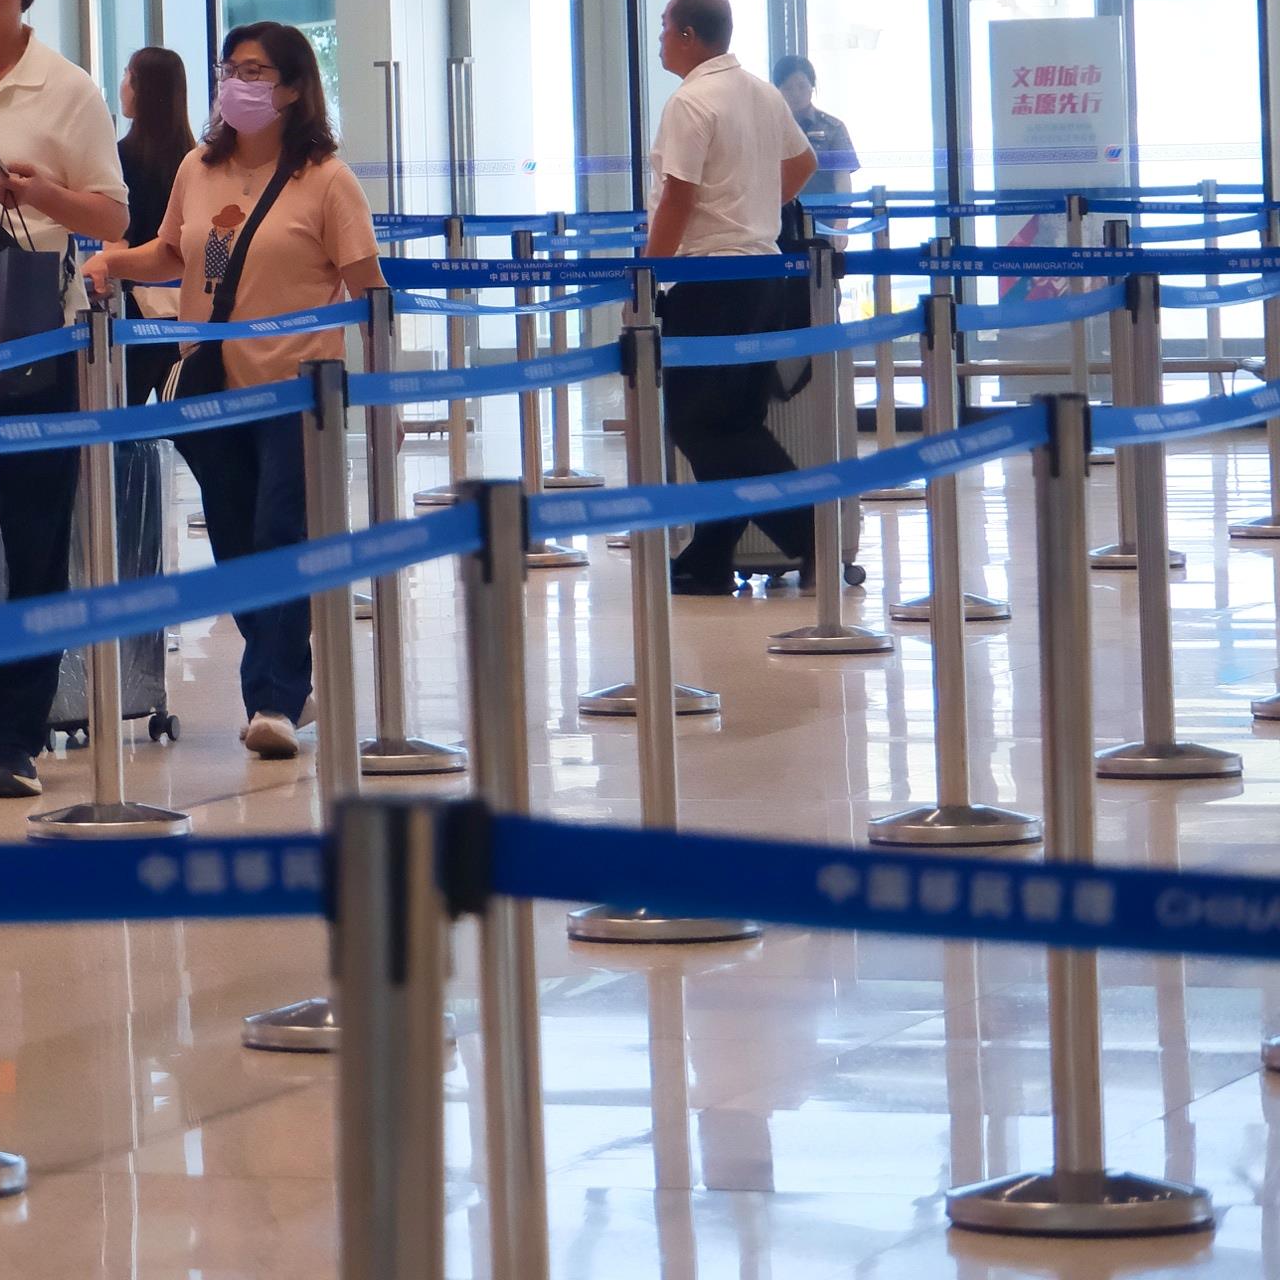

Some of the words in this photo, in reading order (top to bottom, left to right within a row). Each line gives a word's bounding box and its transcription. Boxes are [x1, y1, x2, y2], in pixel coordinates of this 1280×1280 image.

[1011, 64, 1103, 88] 文明城市
[1011, 92, 1103, 115] 志愿先行
[993, 261, 1021, 270] CHINA
[489, 271, 552, 282] 中国移民管理
[559, 270, 586, 279] CHINA
